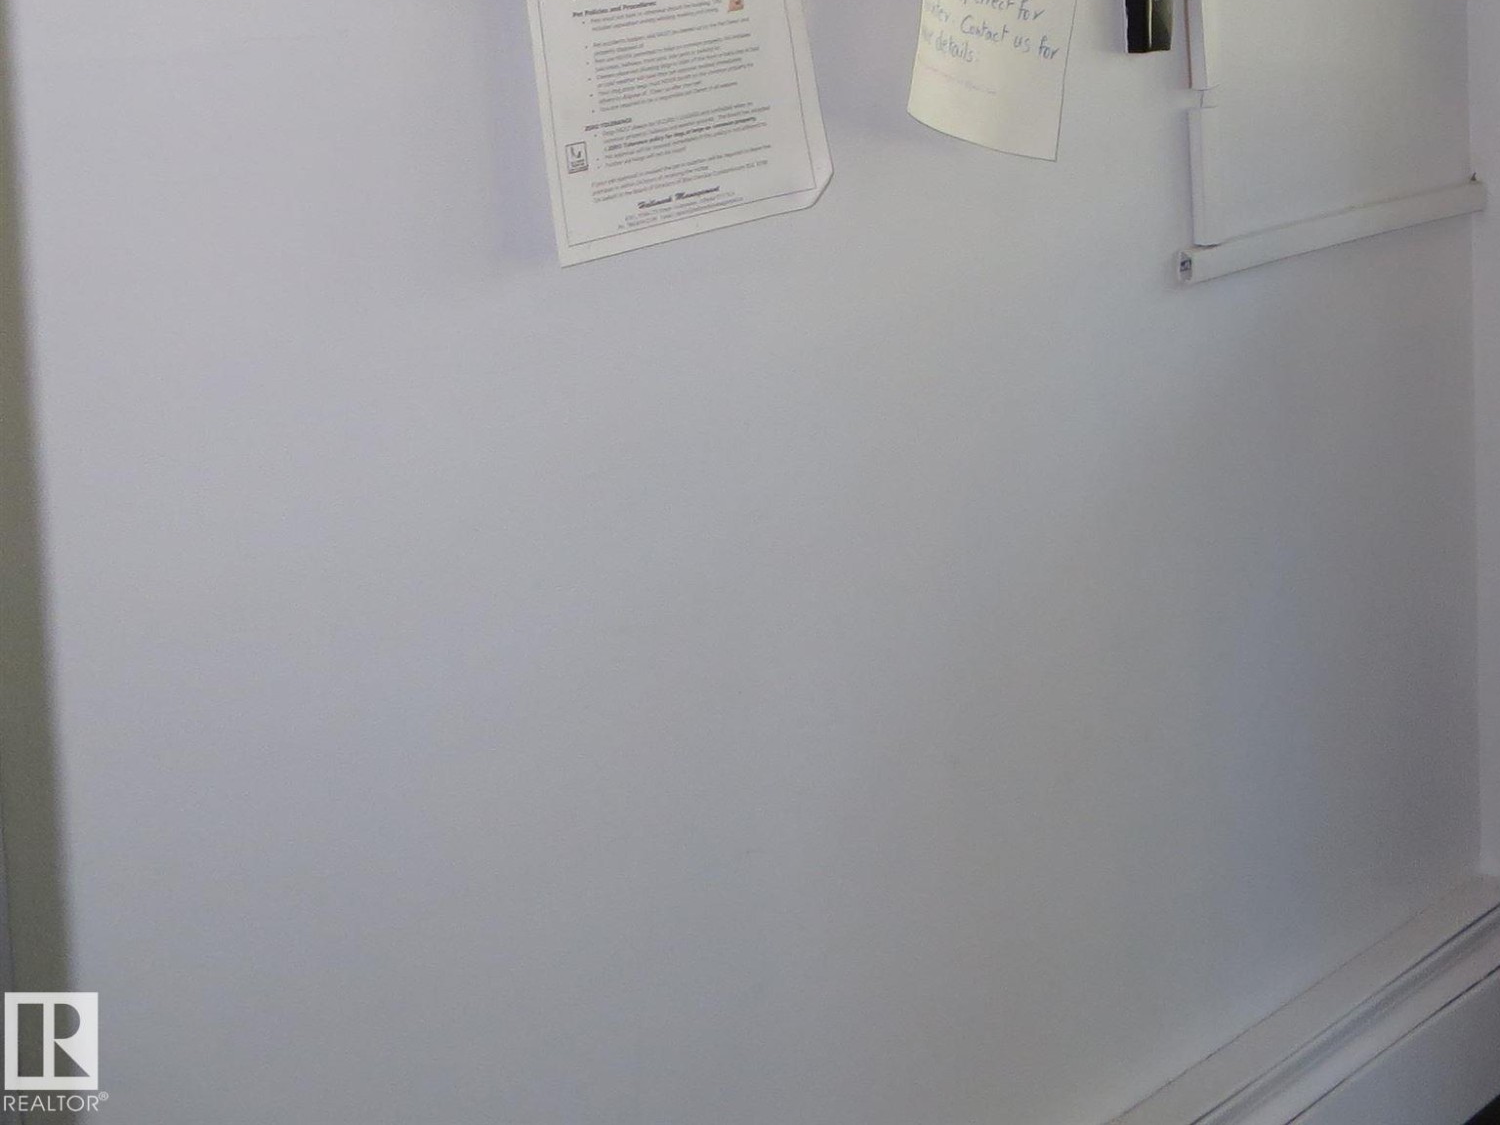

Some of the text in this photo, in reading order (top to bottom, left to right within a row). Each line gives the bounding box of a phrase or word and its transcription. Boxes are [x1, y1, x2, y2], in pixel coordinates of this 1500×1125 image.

[961, 14, 1009, 42] Contact
[1014, 35, 1031, 53] us
[1039, 35, 1060, 60] for
